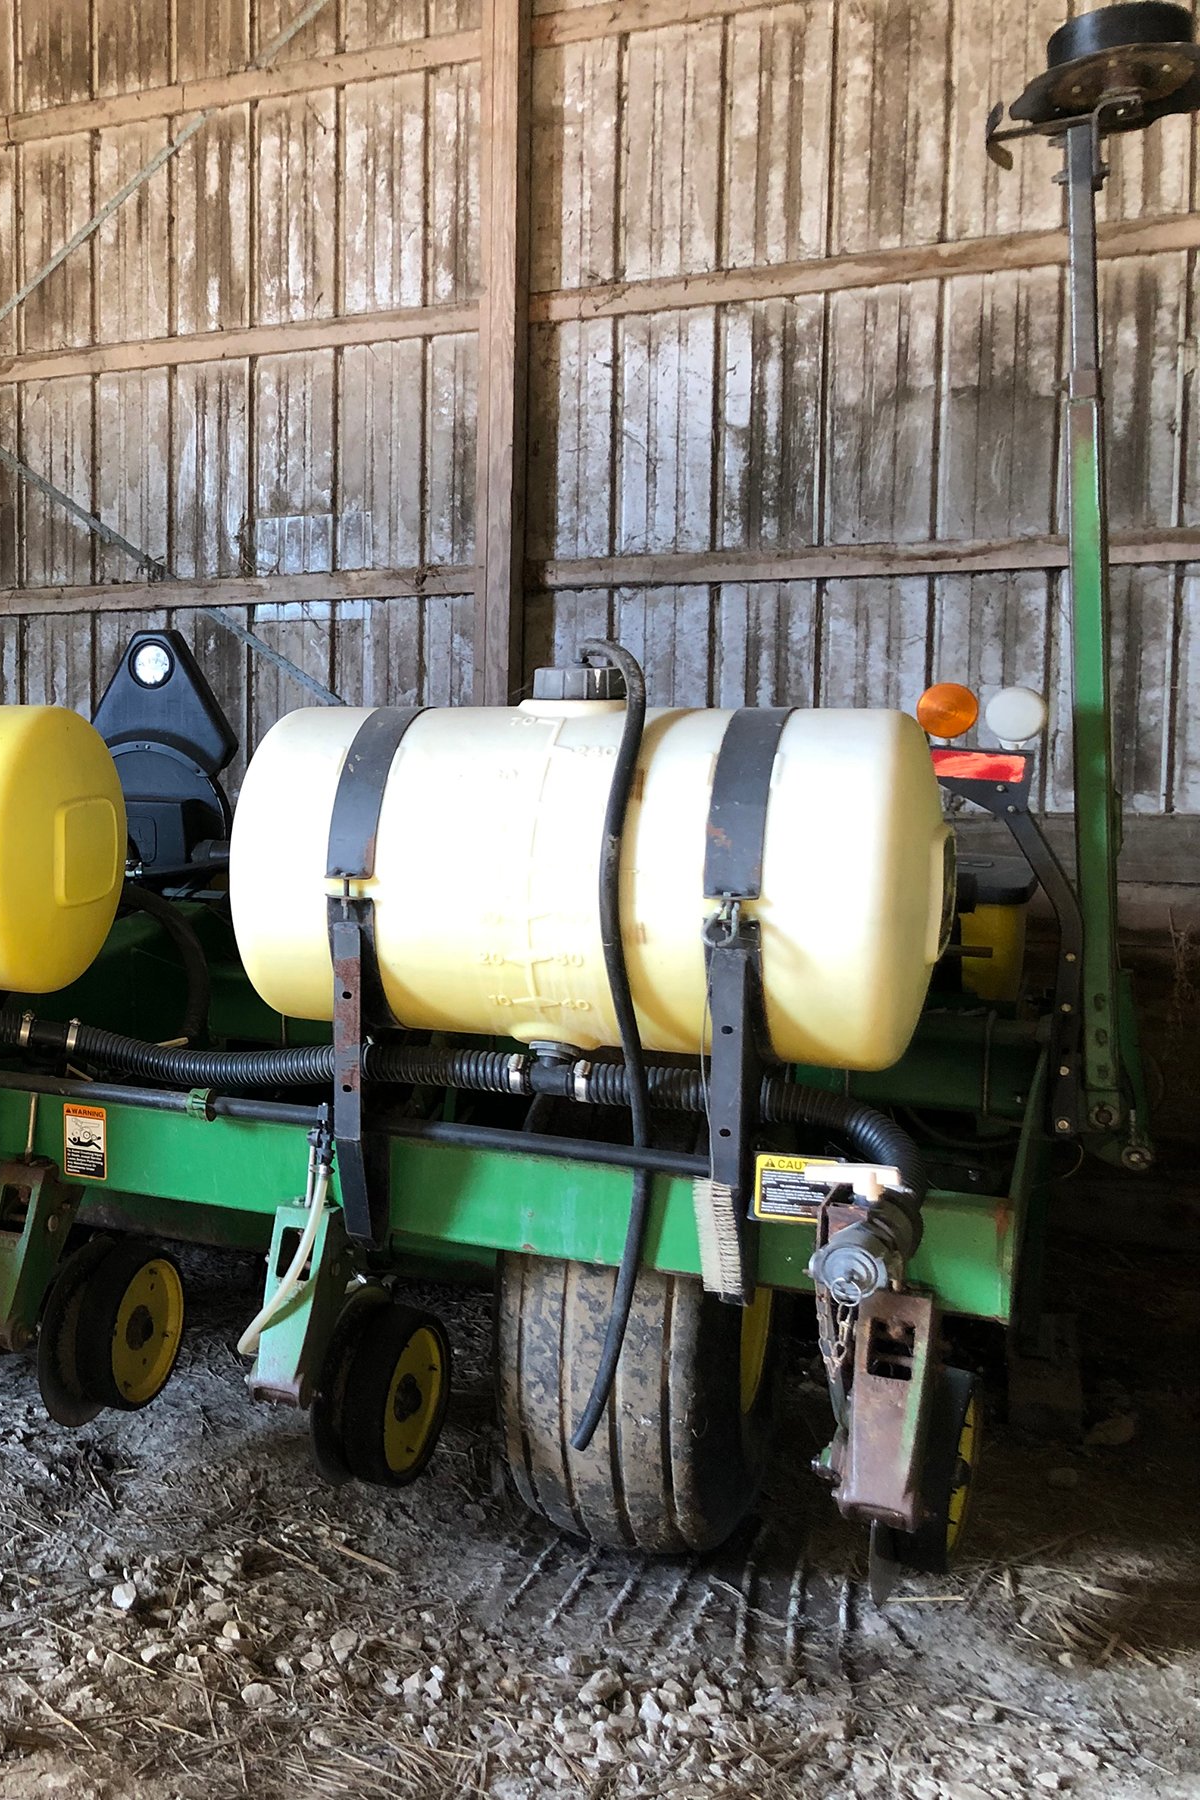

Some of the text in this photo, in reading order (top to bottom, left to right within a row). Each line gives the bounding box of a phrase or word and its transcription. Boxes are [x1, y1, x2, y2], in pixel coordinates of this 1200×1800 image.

[560, 998, 592, 1012] 40
[72, 1108, 103, 1117] WARNING
[778, 1160, 808, 1169] CAUT
